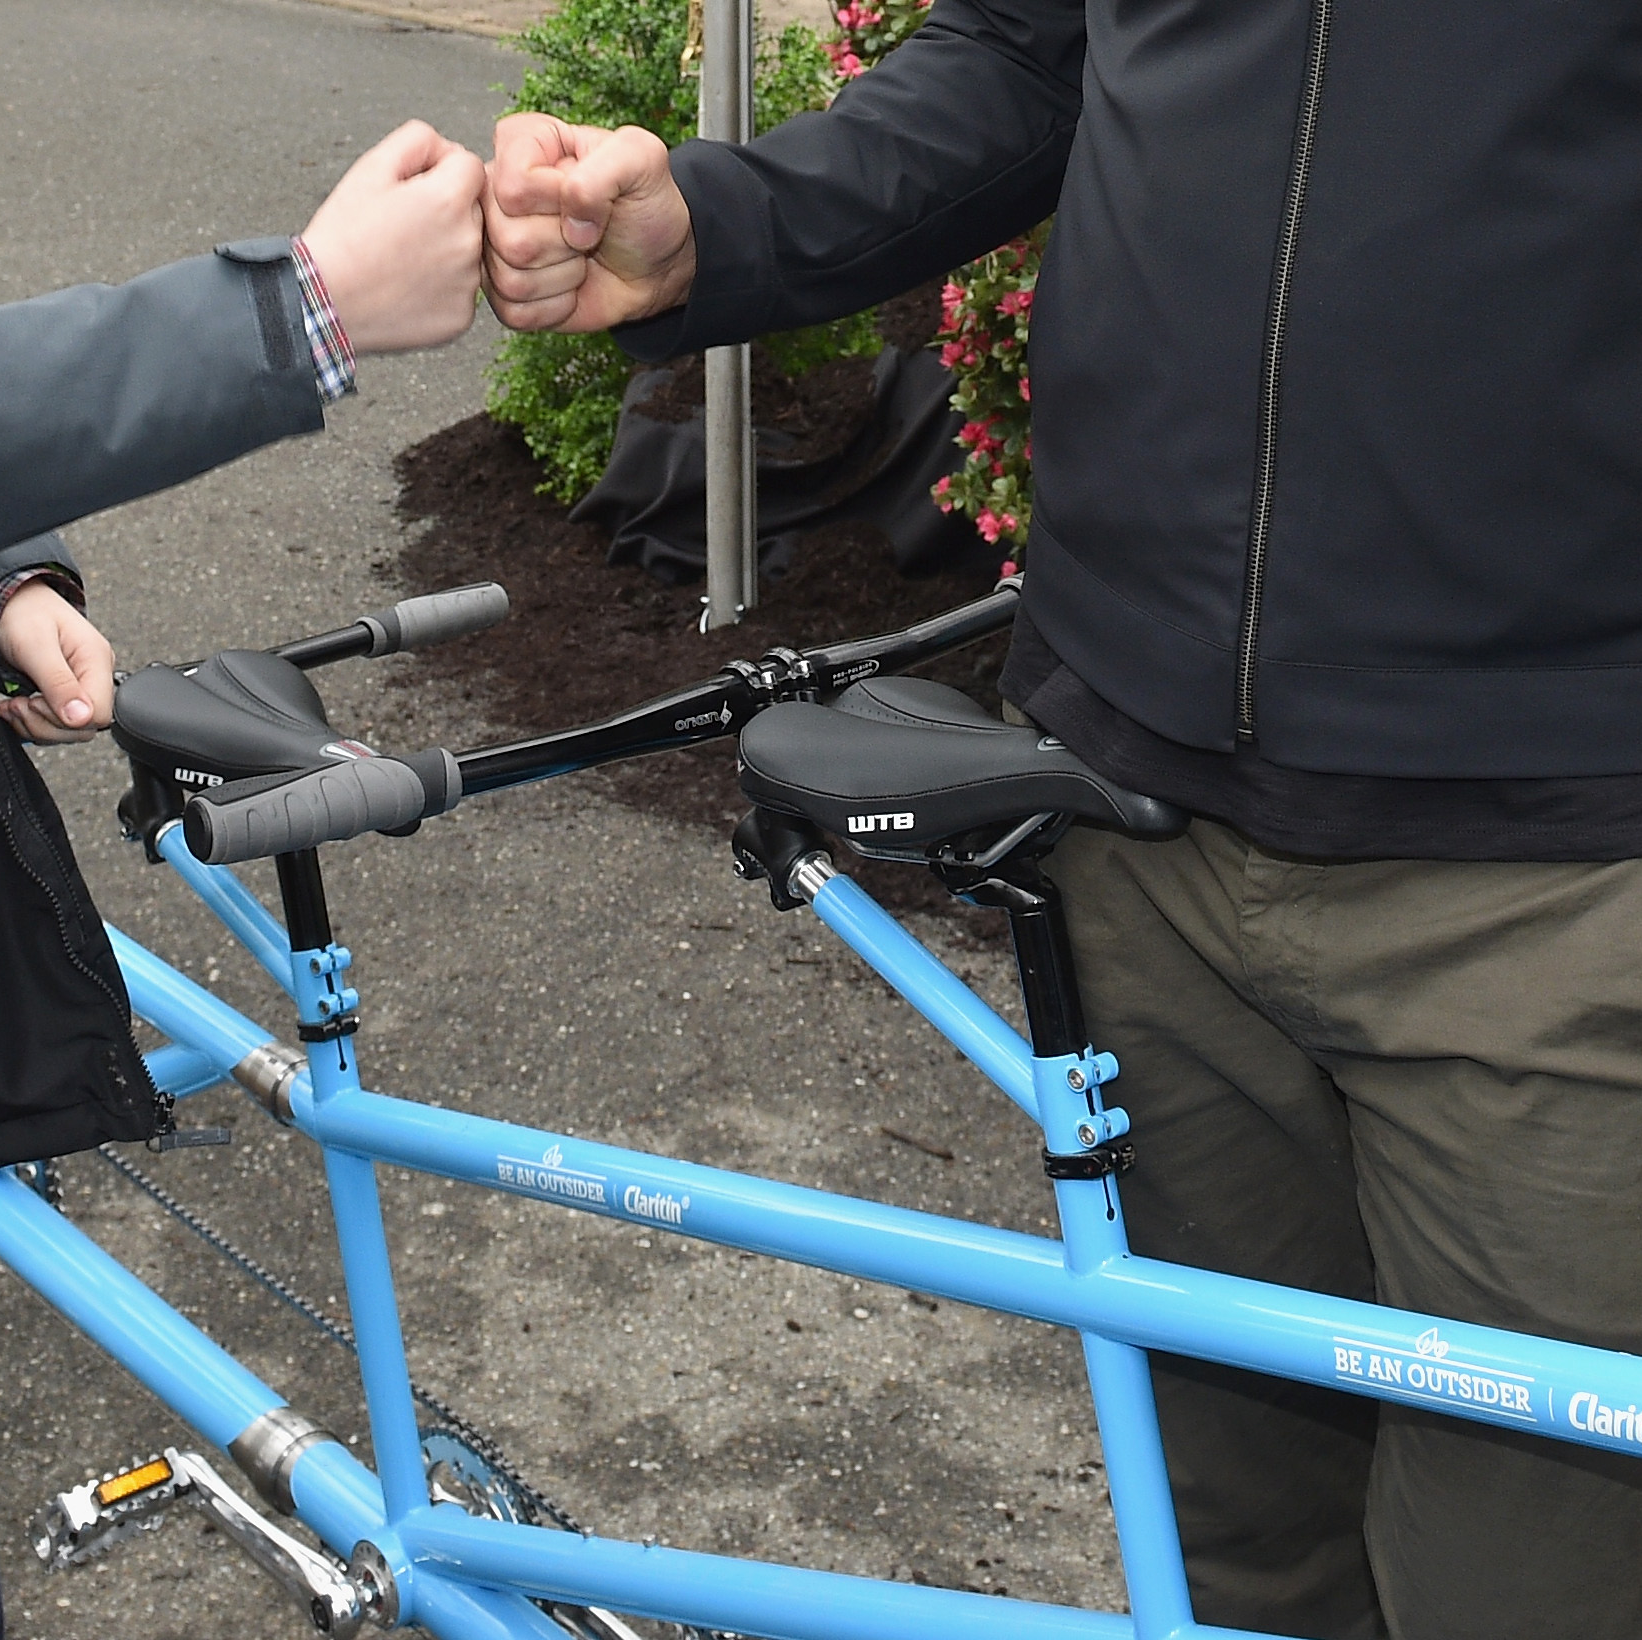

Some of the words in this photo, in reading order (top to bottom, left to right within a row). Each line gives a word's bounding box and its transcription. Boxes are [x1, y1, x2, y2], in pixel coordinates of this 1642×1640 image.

[175, 768, 223, 787] WTB
[848, 813, 914, 833] WTB
[497, 1163, 515, 1181] BE
[517, 1167, 536, 1188] AN
[538, 1172, 606, 1202] OUTSIDER
[1334, 1346, 1363, 1373] BE
[1368, 1354, 1402, 1384] AN
[1407, 1362, 1532, 1412] OUTSIDER
